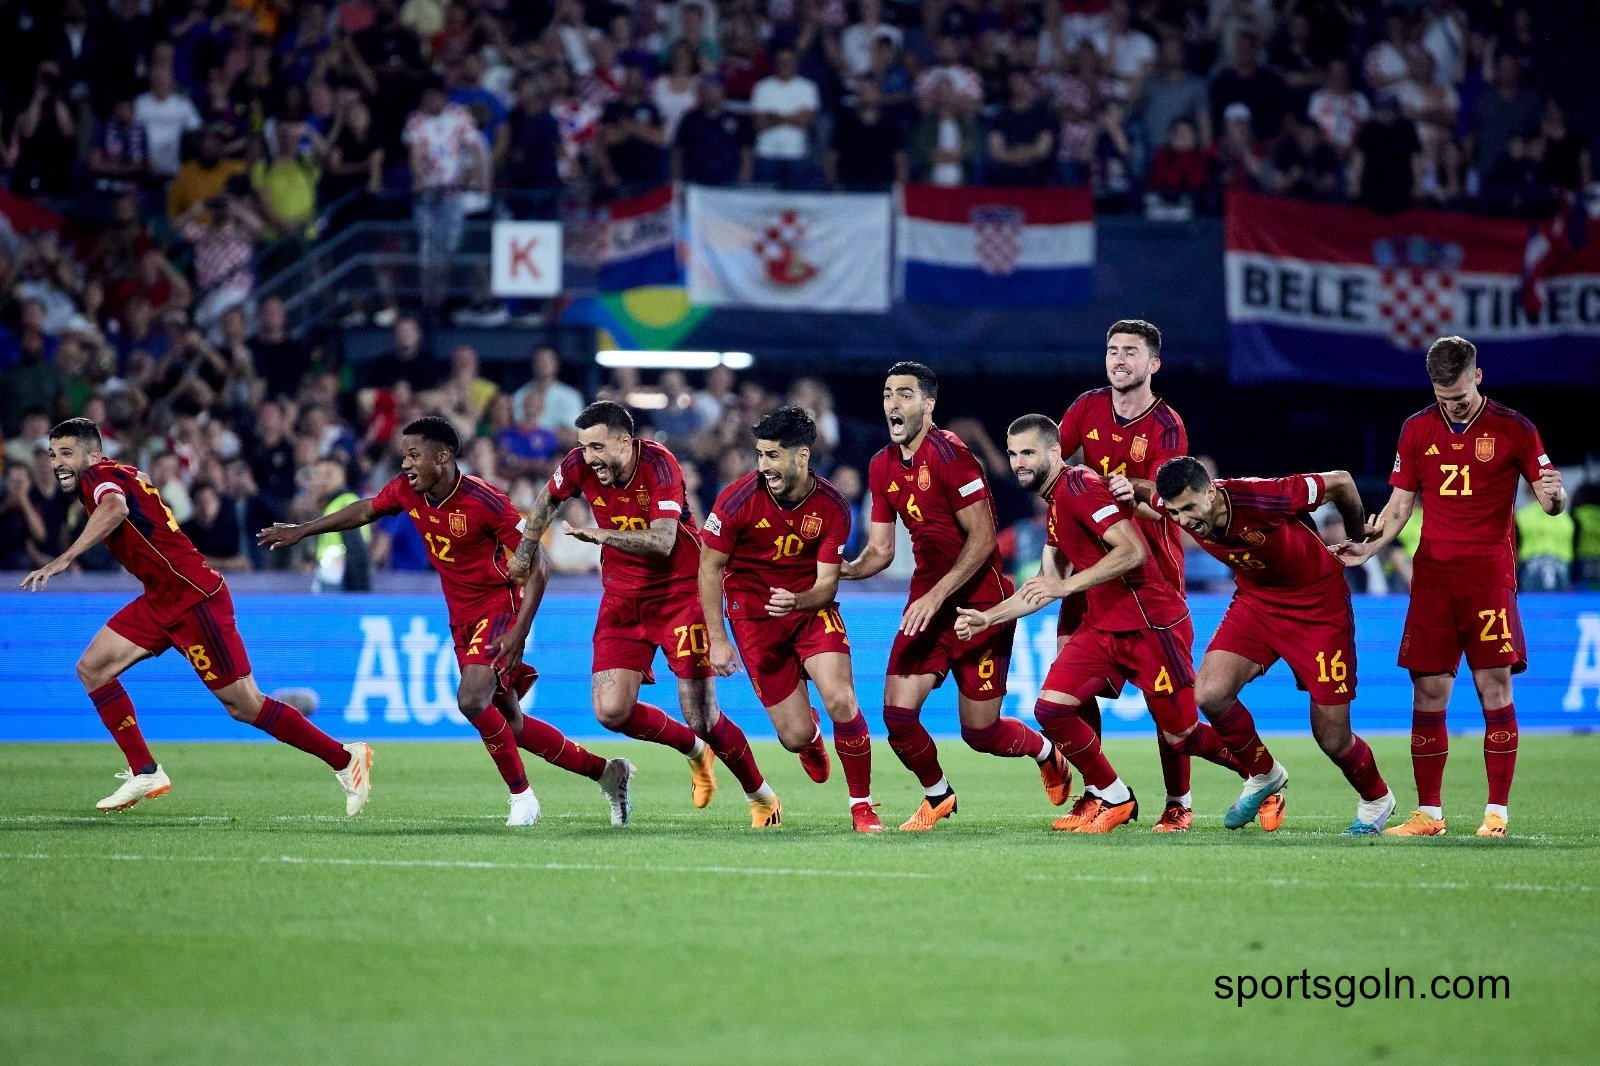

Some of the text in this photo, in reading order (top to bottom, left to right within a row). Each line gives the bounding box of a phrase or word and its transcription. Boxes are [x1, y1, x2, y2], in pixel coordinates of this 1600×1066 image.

[508, 237, 542, 281] K
[1242, 264, 1367, 323] BELE
[1439, 464, 1473, 496] 21
[906, 493, 924, 522] 6
[424, 532, 455, 563] 12
[772, 533, 805, 562] 10
[673, 623, 709, 658] 20
[1478, 607, 1512, 642] 21
[978, 649, 995, 679] 6
[1154, 665, 1174, 695] 4
[1315, 649, 1347, 683] 16
